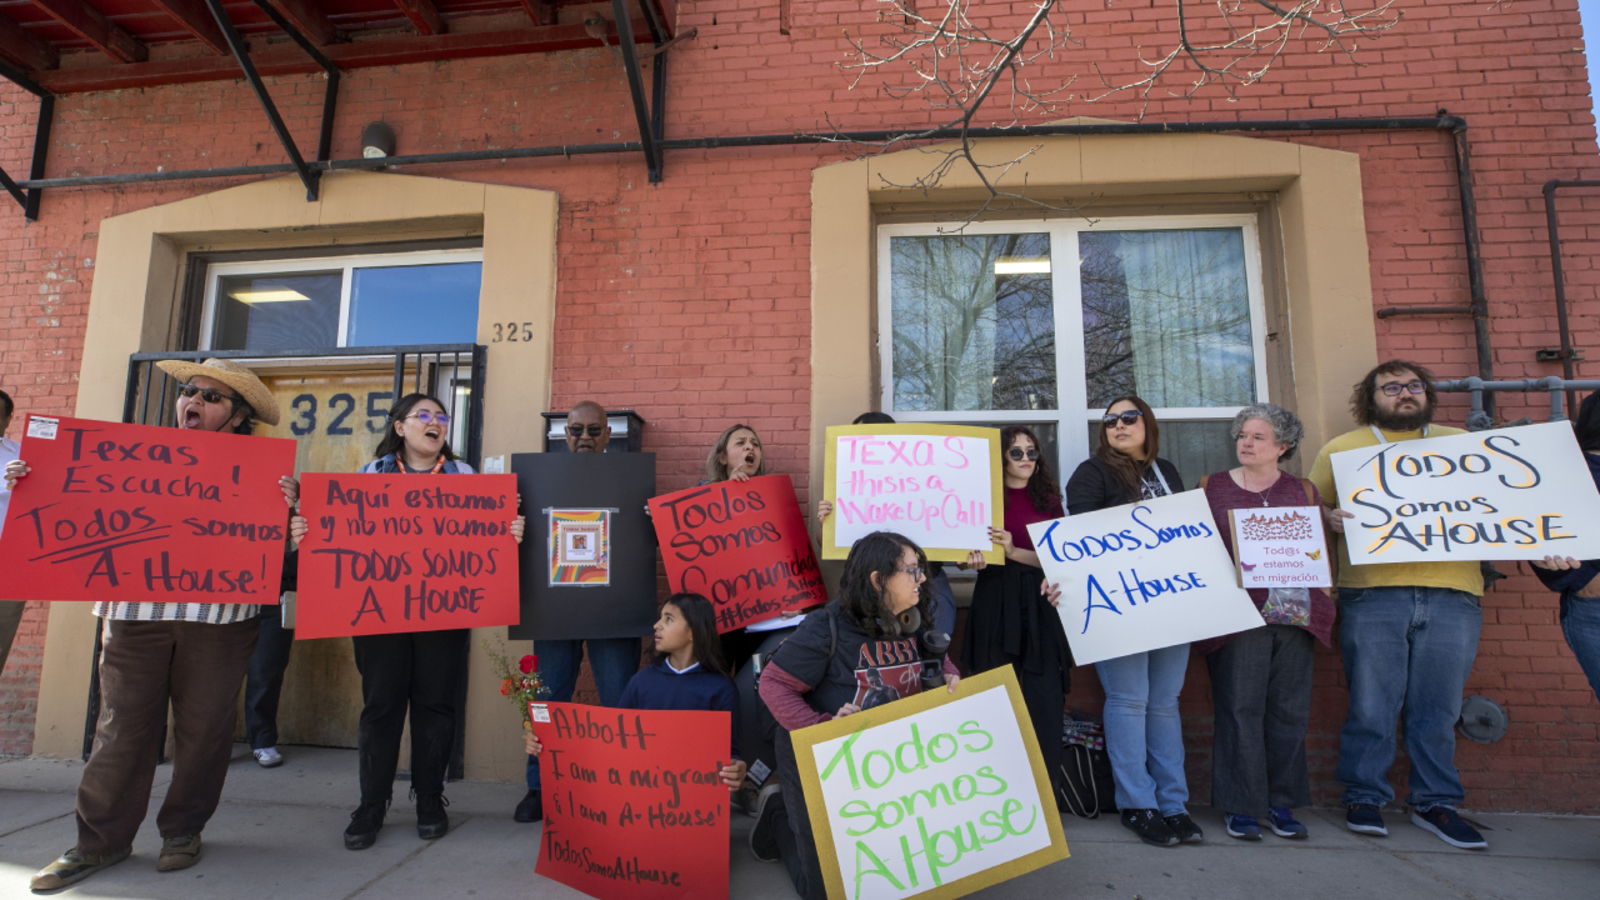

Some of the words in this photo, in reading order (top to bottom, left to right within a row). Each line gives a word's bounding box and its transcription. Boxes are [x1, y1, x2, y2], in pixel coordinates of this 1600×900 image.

[492, 322, 533, 343] 325
[290, 391, 394, 436] 325
[63, 428, 199, 466] Texas
[62, 465, 241, 502] Escucha!
[926, 475, 955, 493] a
[1357, 435, 1541, 500] TODOS
[326, 479, 392, 520] Aquí
[404, 487, 507, 510] estamos
[660, 487, 766, 532] Todos
[837, 497, 904, 525] Wake
[907, 498, 940, 531] Up
[941, 494, 985, 529] Call
[1348, 486, 1498, 530] Somos
[14, 502, 157, 550] Todos
[181, 517, 284, 542] somos
[320, 516, 335, 543] y
[347, 517, 376, 536] no
[384, 516, 424, 536] nos
[433, 516, 507, 537] vamos
[311, 548, 412, 589] TODOS
[422, 548, 499, 578] SOMOS
[1263, 546, 1300, 556] Tod@s
[1263, 560, 1304, 569] estamos
[681, 541, 819, 606] Comunidad
[1252, 574, 1265, 582] en
[1268, 573, 1319, 584] migración
[350, 586, 386, 627] A
[404, 580, 486, 621] HOUSE
[552, 707, 656, 750] Abbott
[549, 750, 565, 781] I
[570, 762, 597, 783] am
[608, 767, 622, 786] a
[820, 718, 993, 791] Todos
[580, 803, 607, 826] am
